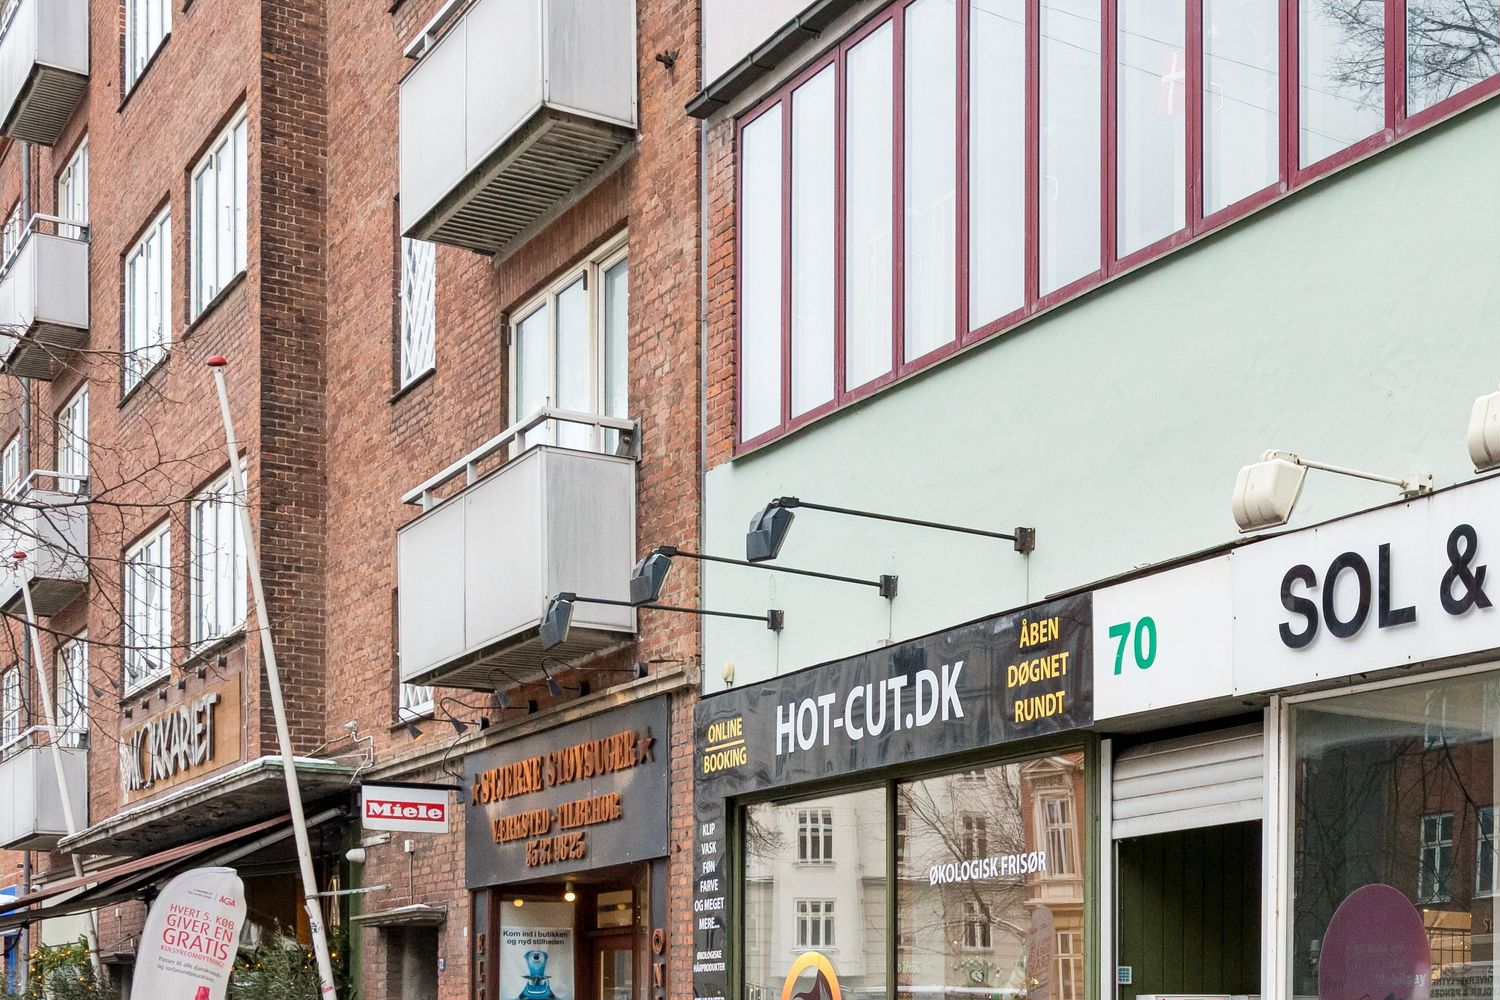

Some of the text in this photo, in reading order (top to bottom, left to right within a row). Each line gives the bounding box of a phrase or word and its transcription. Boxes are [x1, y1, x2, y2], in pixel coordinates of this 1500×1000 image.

[1278, 542, 1416, 649] SOL
[1439, 523, 1493, 616] &
[1019, 616, 1059, 649] ÅBEN
[1109, 616, 1157, 675] 70
[1007, 651, 1069, 688] DØGNET
[775, 660, 965, 756] HOT-CUT.DK
[1014, 690, 1066, 723] RUNDT
[708, 717, 743, 743] ONLINE
[704, 746, 747, 773] BOOKING
[481, 757, 544, 804] STJERNE
[367, 801, 444, 819] Miele
[702, 822, 716, 836] KLIP
[701, 841, 717, 855] VASK
[702, 860, 716, 874] FØN
[930, 850, 1047, 886] ØKOLOGISK FRISØR
[700, 879, 719, 893] FARVE
[219, 896, 236, 907] AGA
[694, 897, 725, 912] OG MEGET
[167, 913, 233, 943] GIVER EN
[170, 903, 235, 930] HVERT 5. KØB
[698, 917, 720, 930] MERE...
[163, 927, 229, 961] GRATIS
[507, 938, 517, 946] og
[518, 938, 532, 946] nyd
[522, 930, 534, 938] ind
[537, 930, 568, 938] butikken
